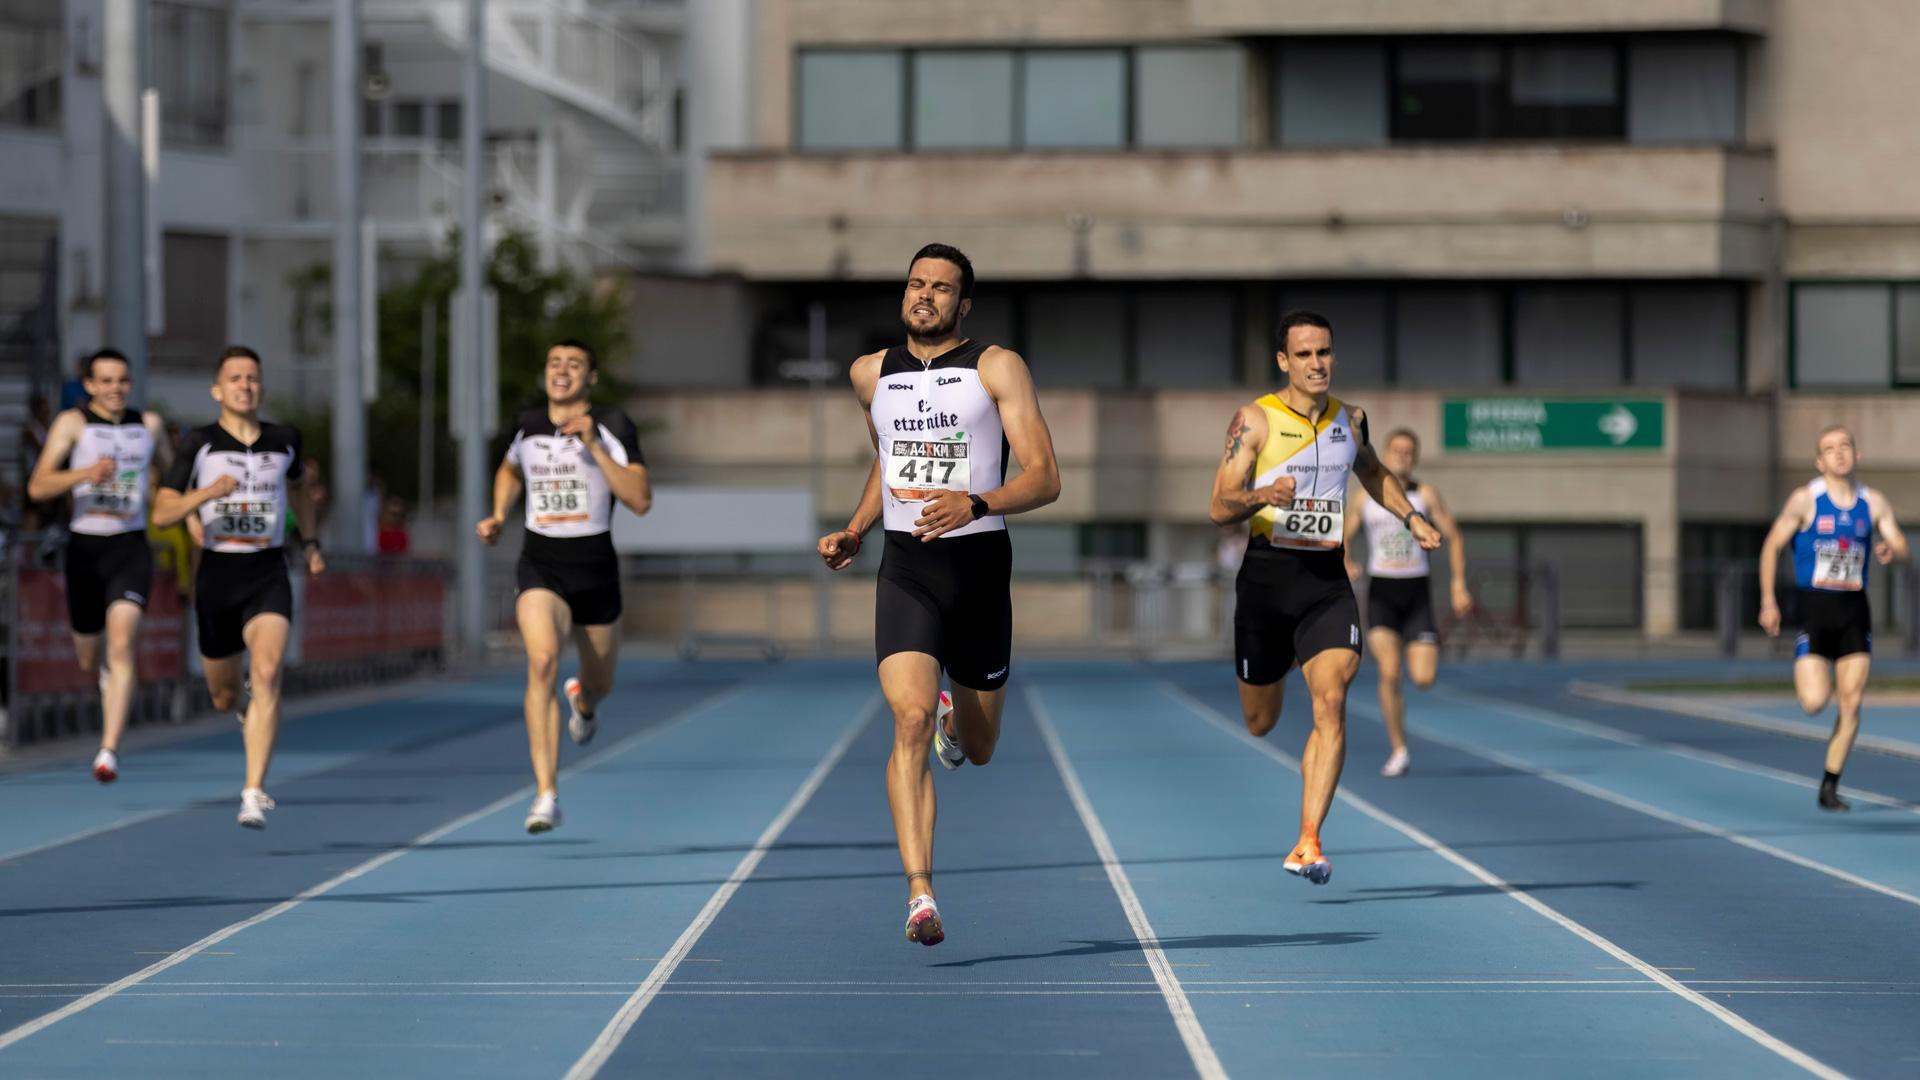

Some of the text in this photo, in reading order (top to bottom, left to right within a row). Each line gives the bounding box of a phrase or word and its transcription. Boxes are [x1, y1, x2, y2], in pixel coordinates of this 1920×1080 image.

[893, 411, 959, 432] etxenike
[909, 442, 950, 457] A4XKM
[898, 459, 956, 485] 417
[537, 493, 578, 512] 398
[222, 516, 267, 534] 365
[1286, 514, 1332, 535] 620
